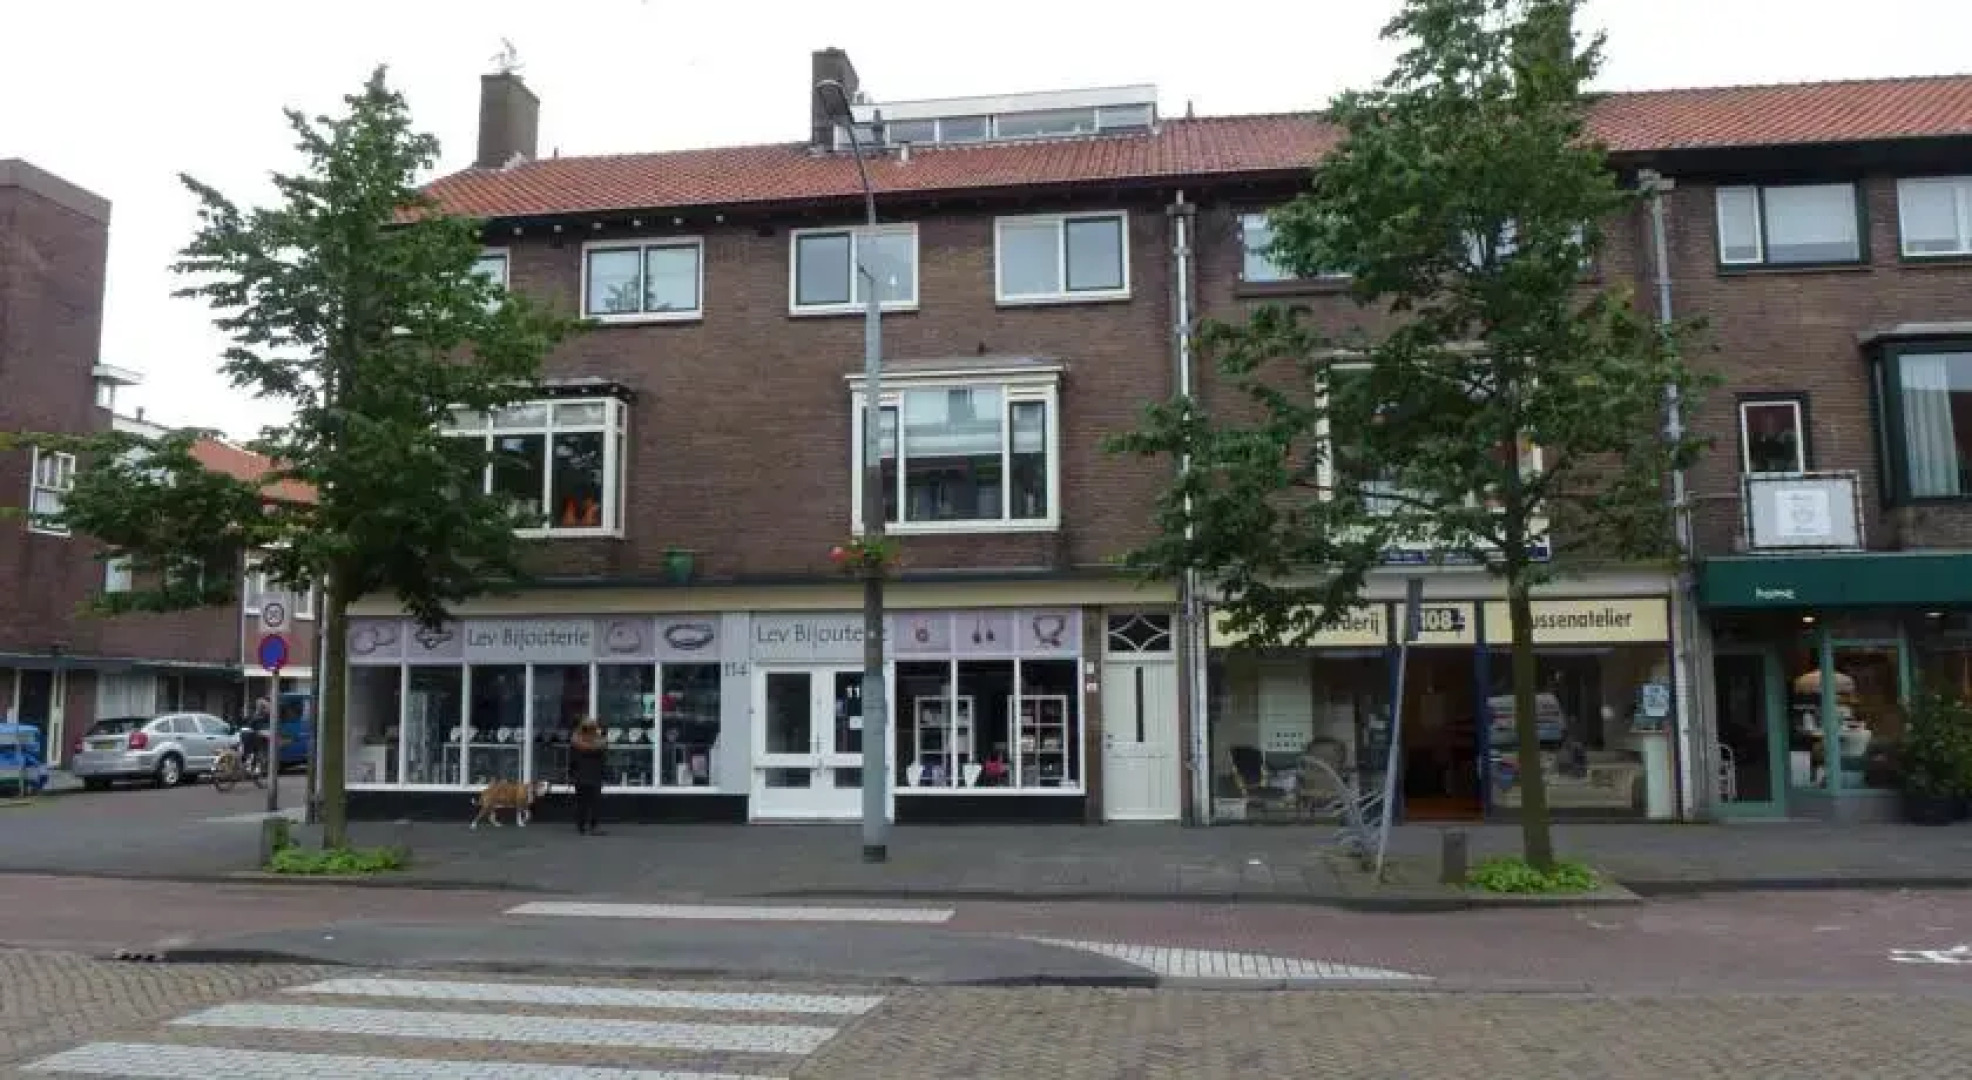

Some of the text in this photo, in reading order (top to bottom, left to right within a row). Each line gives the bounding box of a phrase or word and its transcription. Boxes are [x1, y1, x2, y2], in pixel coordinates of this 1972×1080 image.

[1530, 607, 1632, 629] ussenatelier
[502, 627, 590, 651] Bijouterie
[757, 624, 789, 643] Lev
